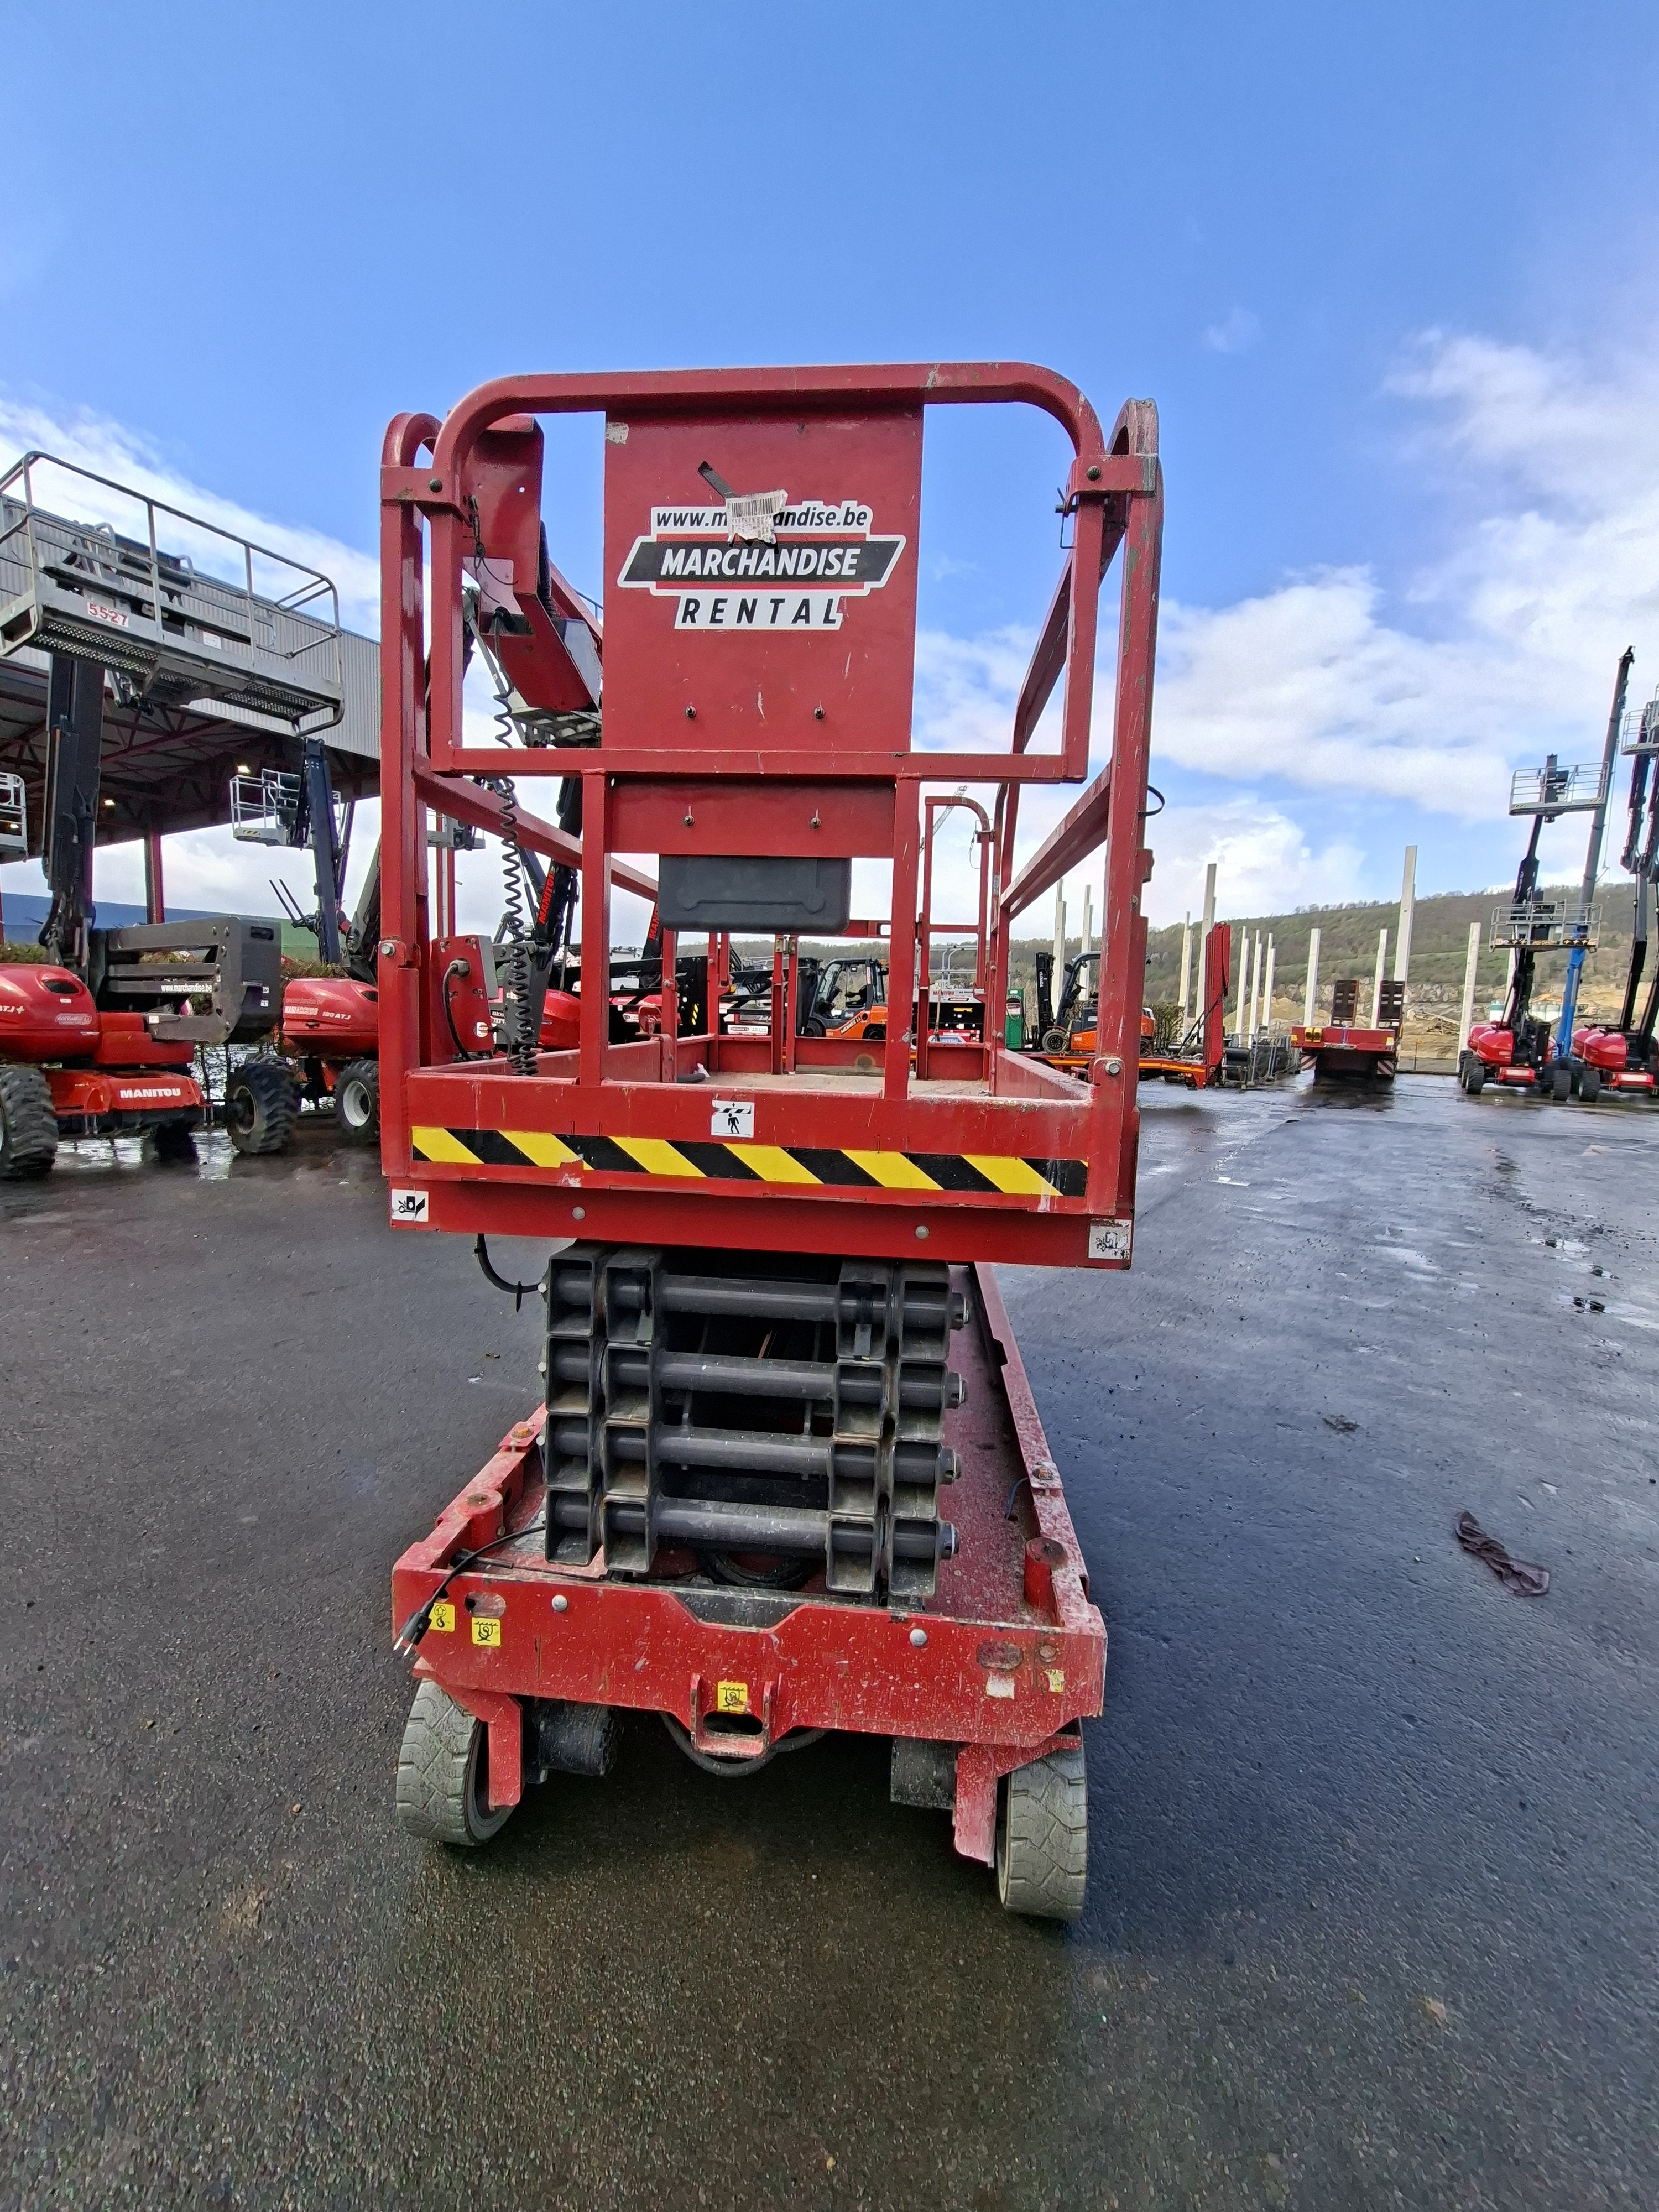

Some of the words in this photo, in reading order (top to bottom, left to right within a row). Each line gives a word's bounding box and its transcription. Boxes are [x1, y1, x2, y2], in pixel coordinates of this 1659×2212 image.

[656, 506, 868, 528] www.mandise.be
[660, 547, 861, 576] MARCHANDISE
[88, 602, 128, 626] 5527
[681, 598, 838, 624] RENTAL
[119, 1088, 181, 1099] MANITOU
